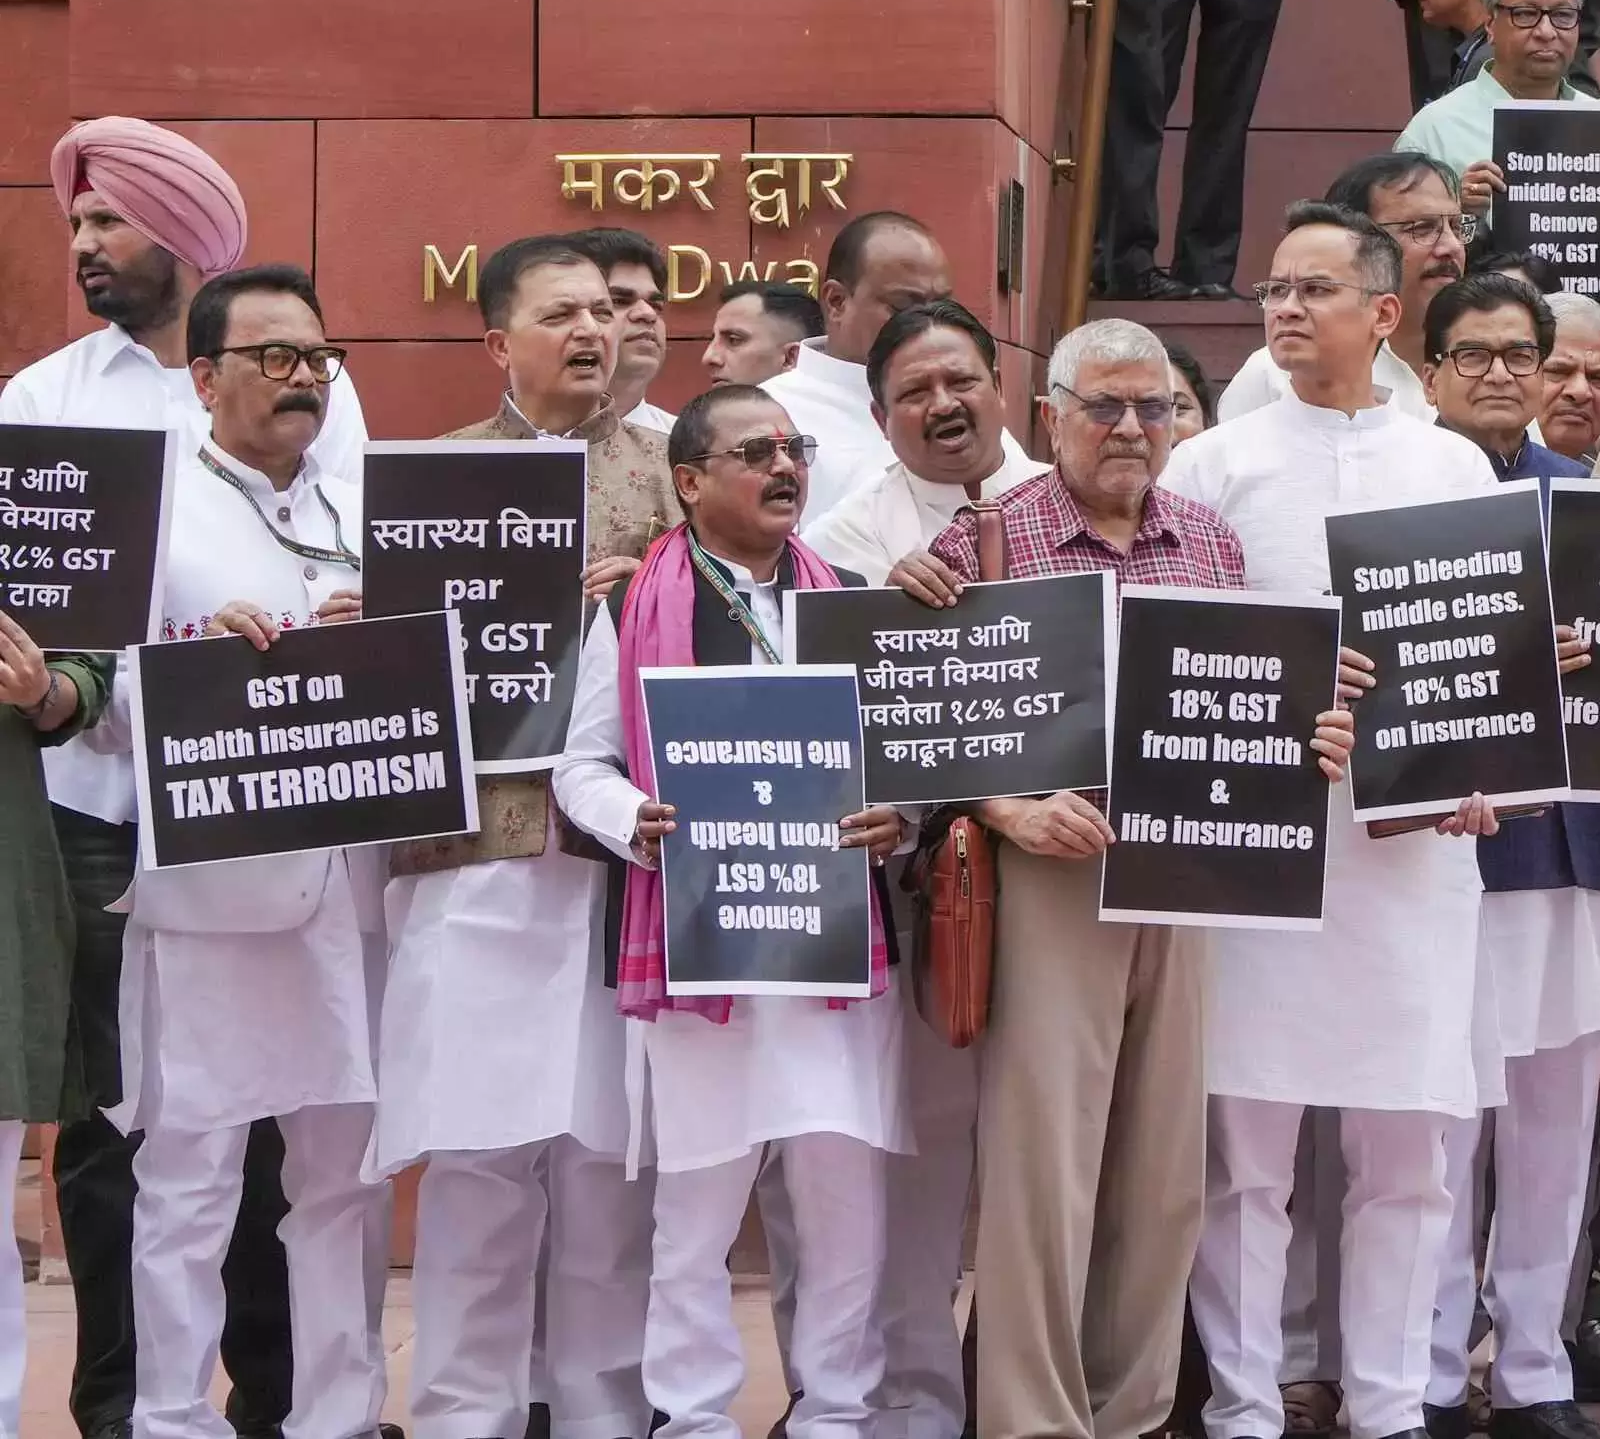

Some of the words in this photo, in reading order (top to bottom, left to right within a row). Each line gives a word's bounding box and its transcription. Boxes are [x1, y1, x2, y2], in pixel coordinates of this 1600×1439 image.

[1507, 151, 1544, 174] Stop
[555, 153, 721, 213] मकर
[741, 153, 854, 230] द्वार
[1508, 182, 1567, 202] middle
[1529, 212, 1598, 233] Remove
[1565, 243, 1599, 263] GST
[21, 461, 89, 494] आणि
[370, 518, 490, 550] स्वास्थ्य
[496, 507, 577, 548] बिमा
[61, 547, 117, 572] GST
[1353, 565, 1410, 593] Stop
[1413, 550, 1523, 585] bleeding
[8, 582, 74, 610] टाका
[444, 577, 504, 609] par
[1361, 598, 1448, 632] middle
[1451, 590, 1525, 619] class.
[480, 622, 552, 652] GST
[872, 627, 961, 653] स्वास्थ्य
[967, 615, 1032, 647] आणि
[1397, 634, 1496, 667] Remove
[865, 659, 936, 690] जीवन
[941, 656, 1041, 687] विम्यावर
[1172, 647, 1283, 682] Remove
[246, 673, 300, 709] GST
[306, 674, 344, 702] on
[487, 661, 556, 704] करो
[1400, 675, 1451, 706] 18%
[1454, 669, 1500, 700] GST
[950, 697, 1005, 725] १८%
[1013, 691, 1065, 717] GST
[1169, 689, 1223, 720] 18%
[1228, 691, 1282, 723] GST
[163, 727, 255, 766] health
[259, 714, 407, 755] insurance
[411, 707, 439, 737] is
[1375, 726, 1407, 750] on
[1410, 711, 1536, 745] insurance
[665, 740, 803, 769] insurance
[807, 740, 852, 770] life
[882, 737, 957, 768] काढून
[962, 731, 1025, 758] टाका
[1142, 729, 1208, 761] from
[1212, 732, 1302, 766] health
[165, 775, 235, 820] TAX
[237, 750, 447, 811] TERRORISM
[752, 780, 773, 805] &
[1209, 779, 1230, 804] &
[690, 821, 776, 851] health
[780, 822, 842, 852] from
[1121, 812, 1167, 843] life
[1172, 814, 1314, 850] insurance
[715, 862, 766, 893] GST
[769, 863, 822, 893] 18%
[718, 905, 822, 935] Remove
